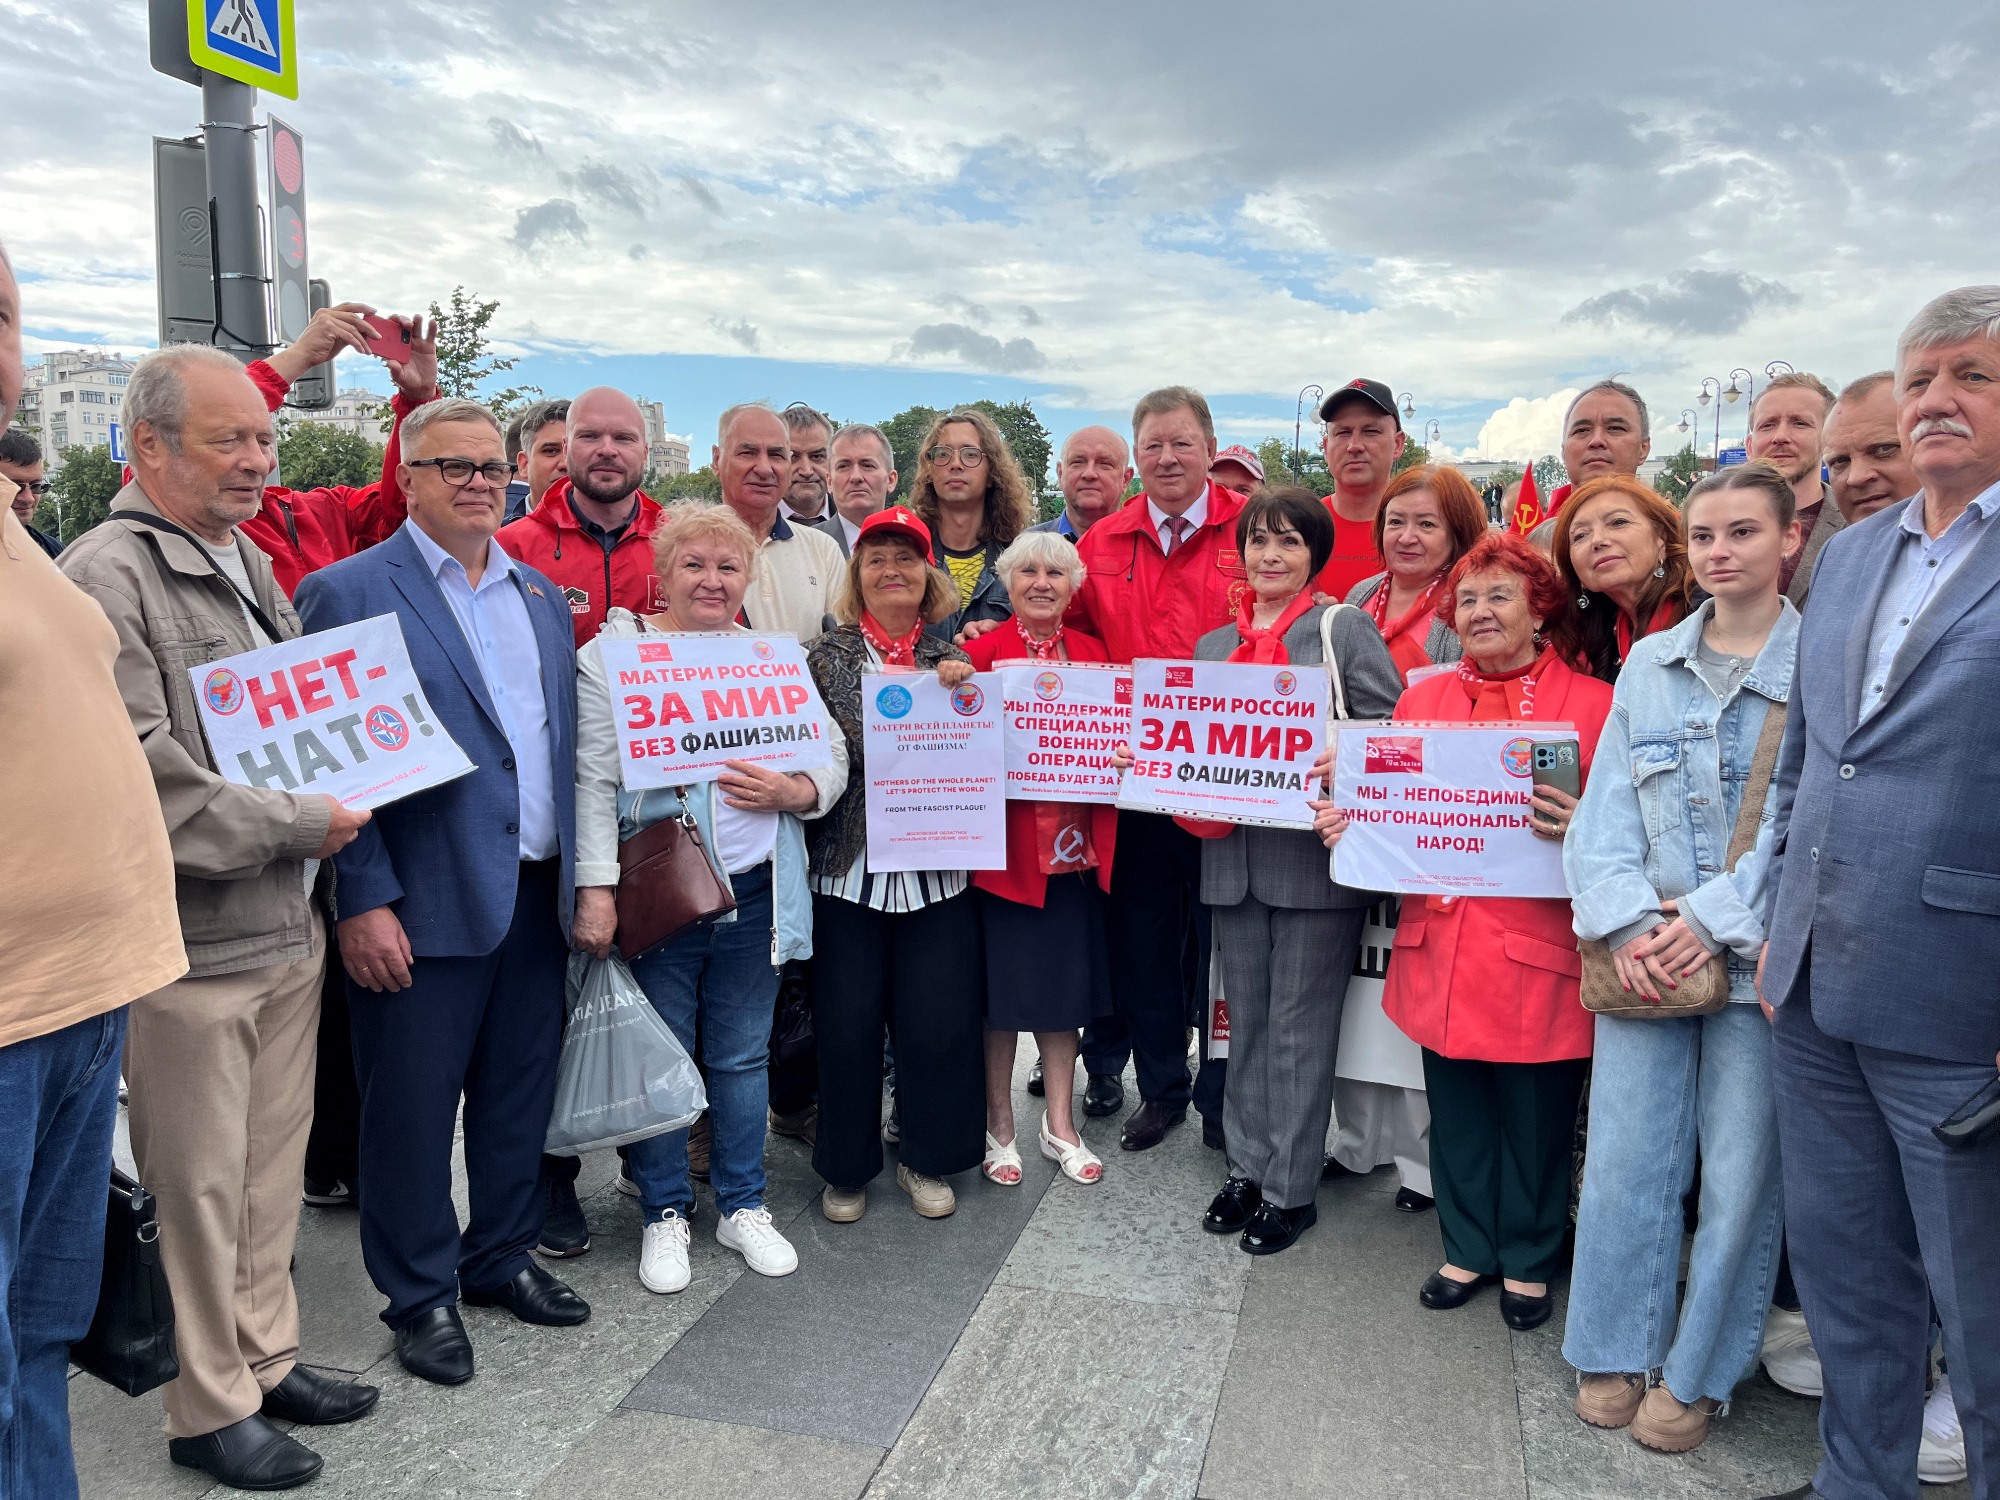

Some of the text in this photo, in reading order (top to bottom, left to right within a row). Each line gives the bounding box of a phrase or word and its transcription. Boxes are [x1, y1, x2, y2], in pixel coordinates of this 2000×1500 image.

[618, 664, 801, 686] МАТЕРИ РОССИИ
[246, 648, 387, 729] НЕТ-
[623, 685, 809, 730] ЗА МИР
[1003, 700, 1029, 712] МЫ
[1143, 694, 1315, 718] МАТЕРИ РОССИИ
[872, 721, 994, 732] МАТЕРИ ВСЕЙ ПЛАНЕТЫ!
[629, 722, 820, 759] БЕЗ ФАШИЗМА!
[897, 732, 971, 742] ЗАЩИТИМ МИР
[1038, 736, 1128, 751] ВОЕННУЮ
[1139, 718, 1313, 762] ЗА МИР
[897, 743, 967, 752] ОТ ФАШИЗМА!
[1007, 771, 1056, 783] ПОБЕДА
[1058, 773, 1097, 785] БУДЕТ
[1099, 776, 1114, 785] ЗА
[1133, 760, 1311, 792] БЕЗ ФАШИЗМА!
[1357, 786, 1387, 800] МЫ
[1416, 835, 1484, 853] НАРОД!
